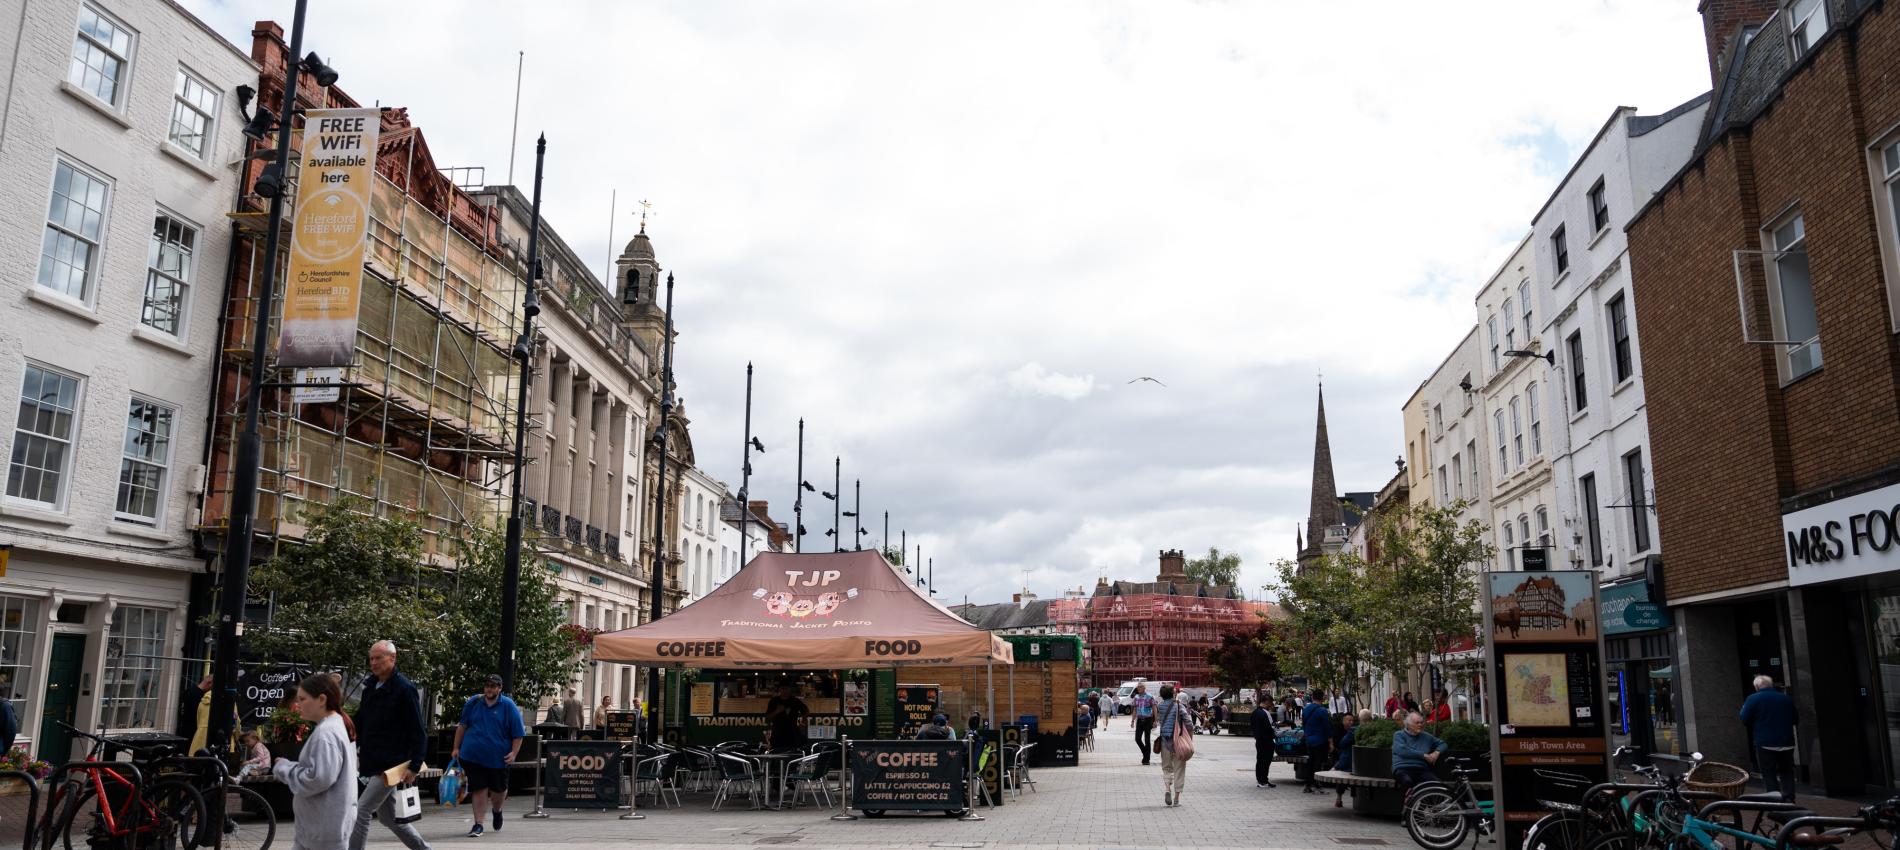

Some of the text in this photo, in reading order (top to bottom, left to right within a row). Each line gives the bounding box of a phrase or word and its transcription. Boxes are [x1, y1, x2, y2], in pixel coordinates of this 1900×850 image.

[320, 118, 365, 133] FREE
[320, 135, 362, 150] WiFi
[309, 156, 366, 167] available
[321, 172, 350, 183] here
[305, 209, 357, 225] Hereford
[304, 225, 330, 234] FREE
[1787, 520, 1844, 567] M&S
[785, 570, 841, 587] TJP
[656, 640, 922, 657] COFFEE FOOD
[246, 686, 284, 702] Open
[697, 716, 768, 727] TRADITIONAL
[815, 716, 863, 727] POTATO
[909, 712, 927, 720] ROLLS
[1519, 741, 1585, 751] High Town Area
[559, 755, 605, 770] FOOD
[876, 752, 938, 767] COFFEE
